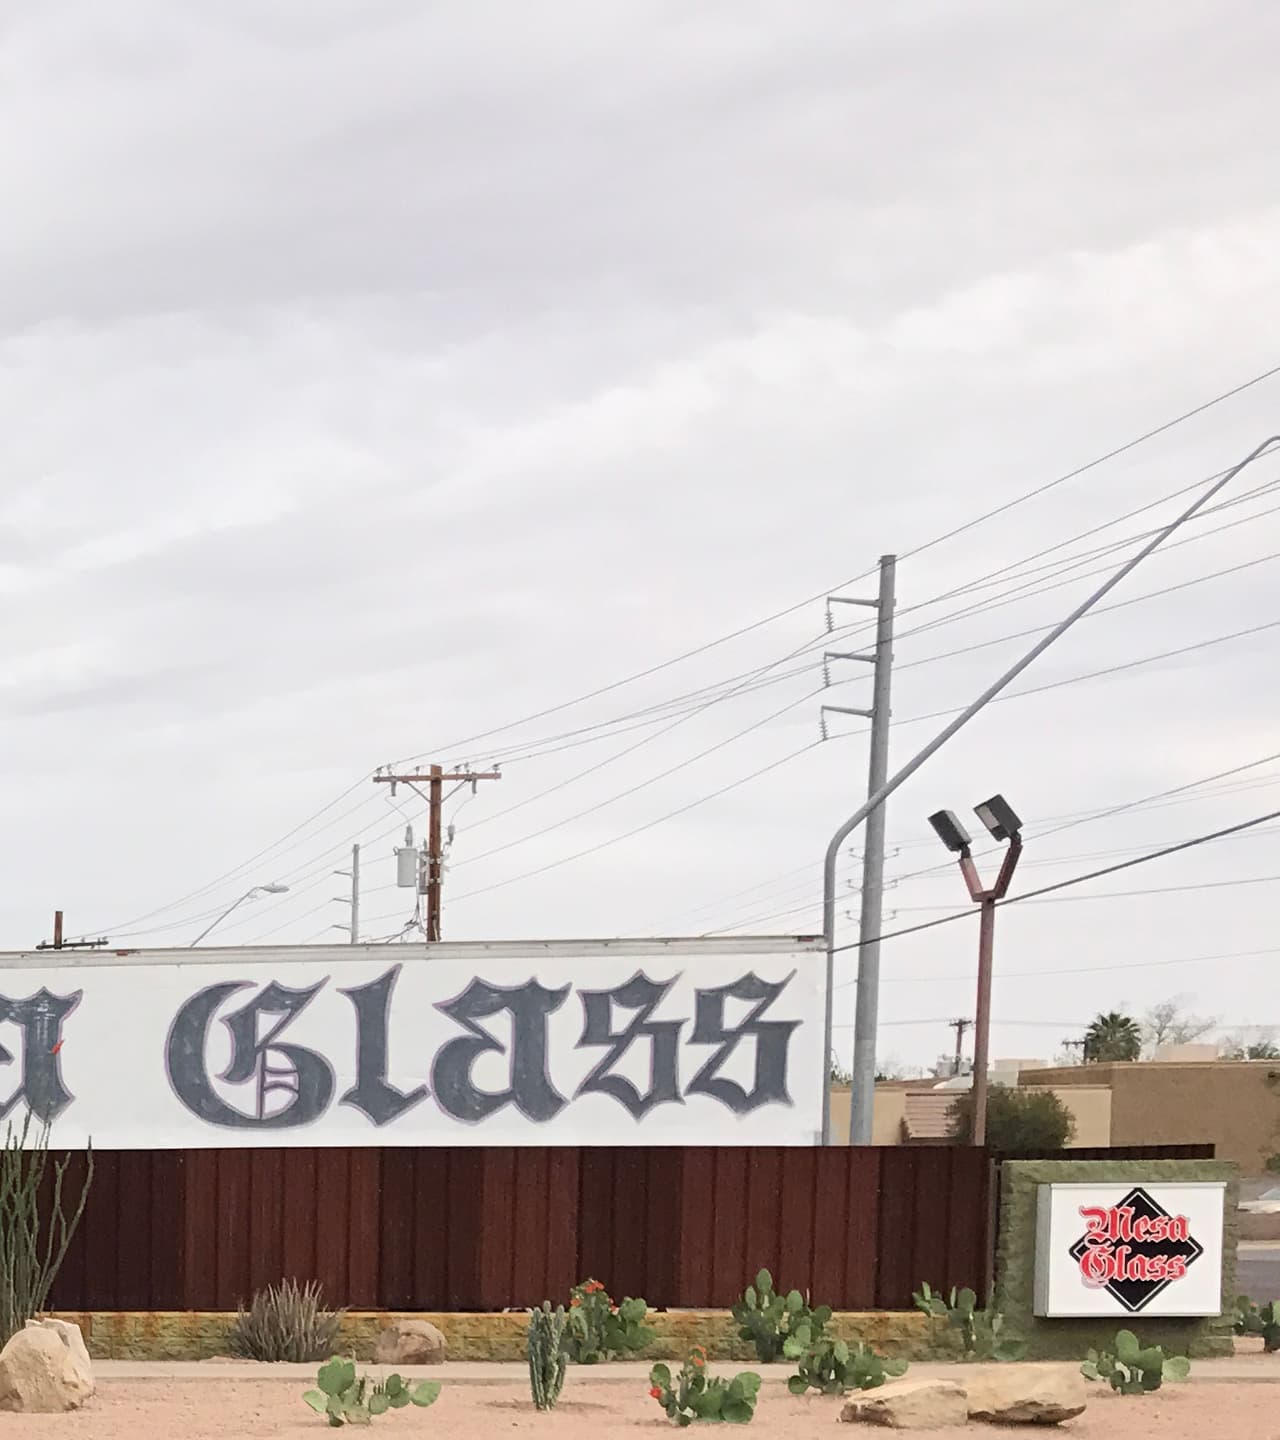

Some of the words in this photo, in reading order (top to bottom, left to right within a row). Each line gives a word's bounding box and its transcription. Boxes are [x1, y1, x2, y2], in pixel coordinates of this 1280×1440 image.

[164, 962, 803, 1130] Glass
[1079, 1206, 1190, 1243] Mesa
[1079, 1243, 1187, 1284] Glass
